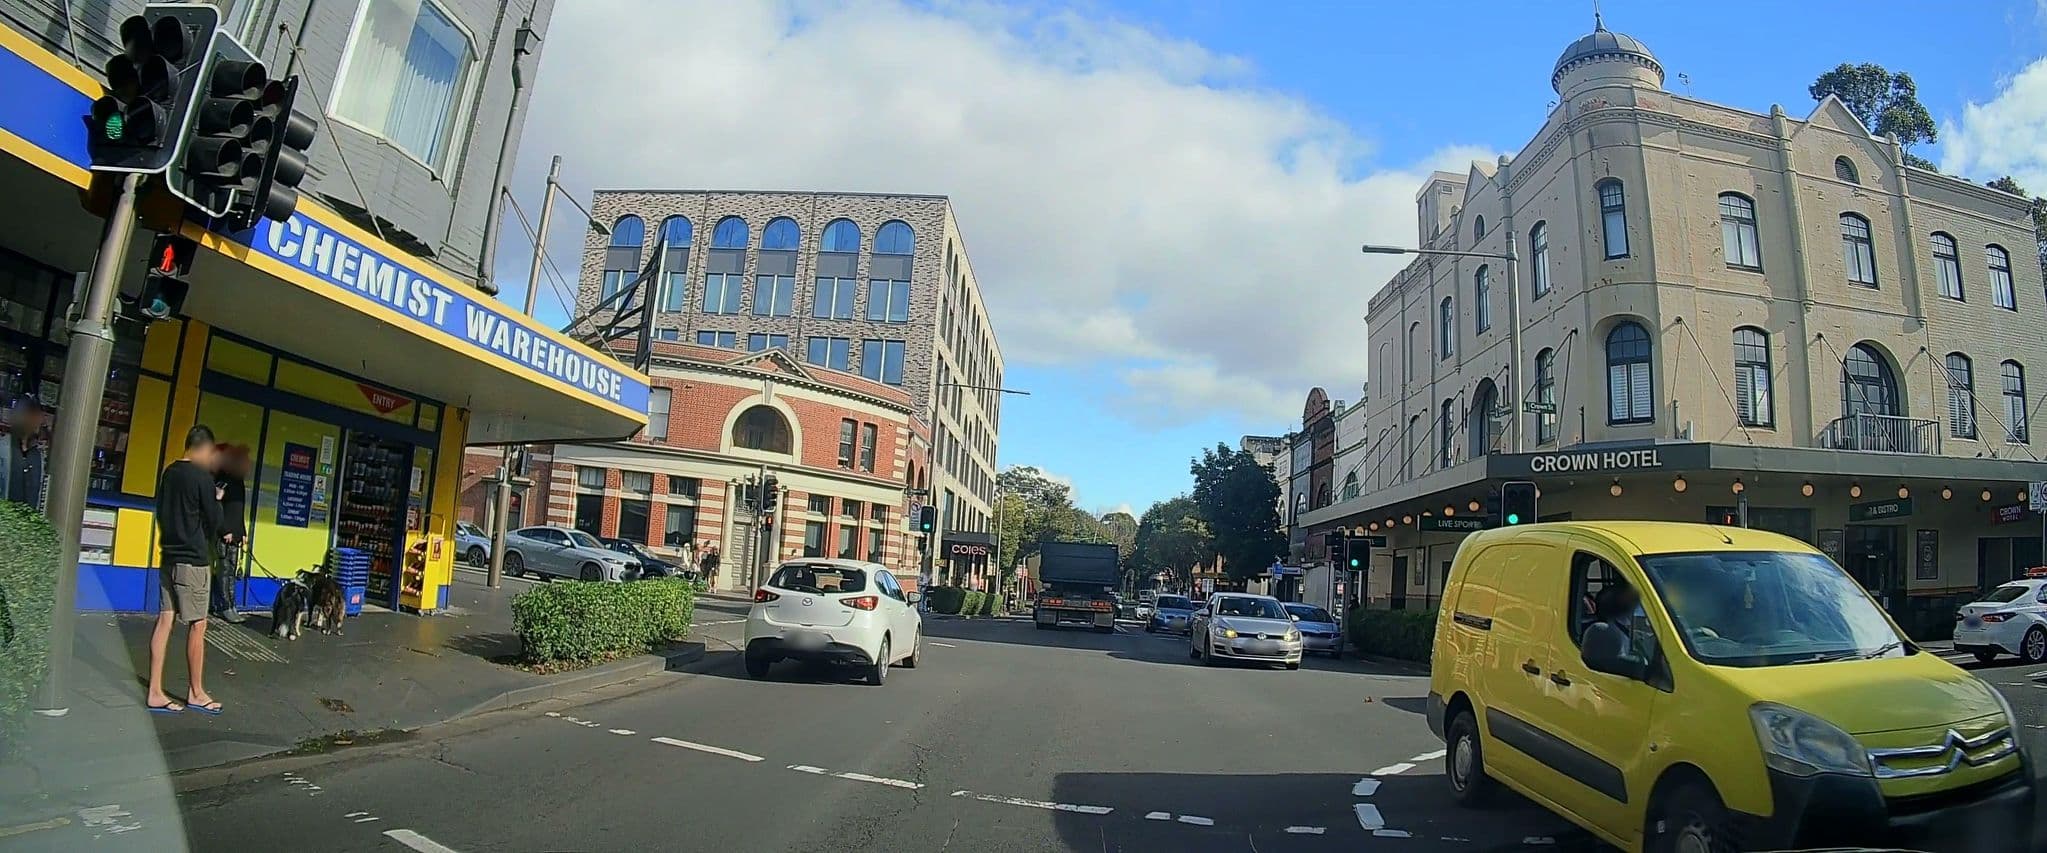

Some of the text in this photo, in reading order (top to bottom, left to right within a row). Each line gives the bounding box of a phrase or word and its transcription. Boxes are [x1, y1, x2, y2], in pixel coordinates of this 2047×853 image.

[268, 215, 622, 401] CHEMIST WAREHOUSE
[372, 393, 396, 409] ENTRY
[1530, 449, 1663, 472] CROWN HOTEL
[1438, 520, 1453, 528] LIVE
[951, 544, 987, 556] coles
